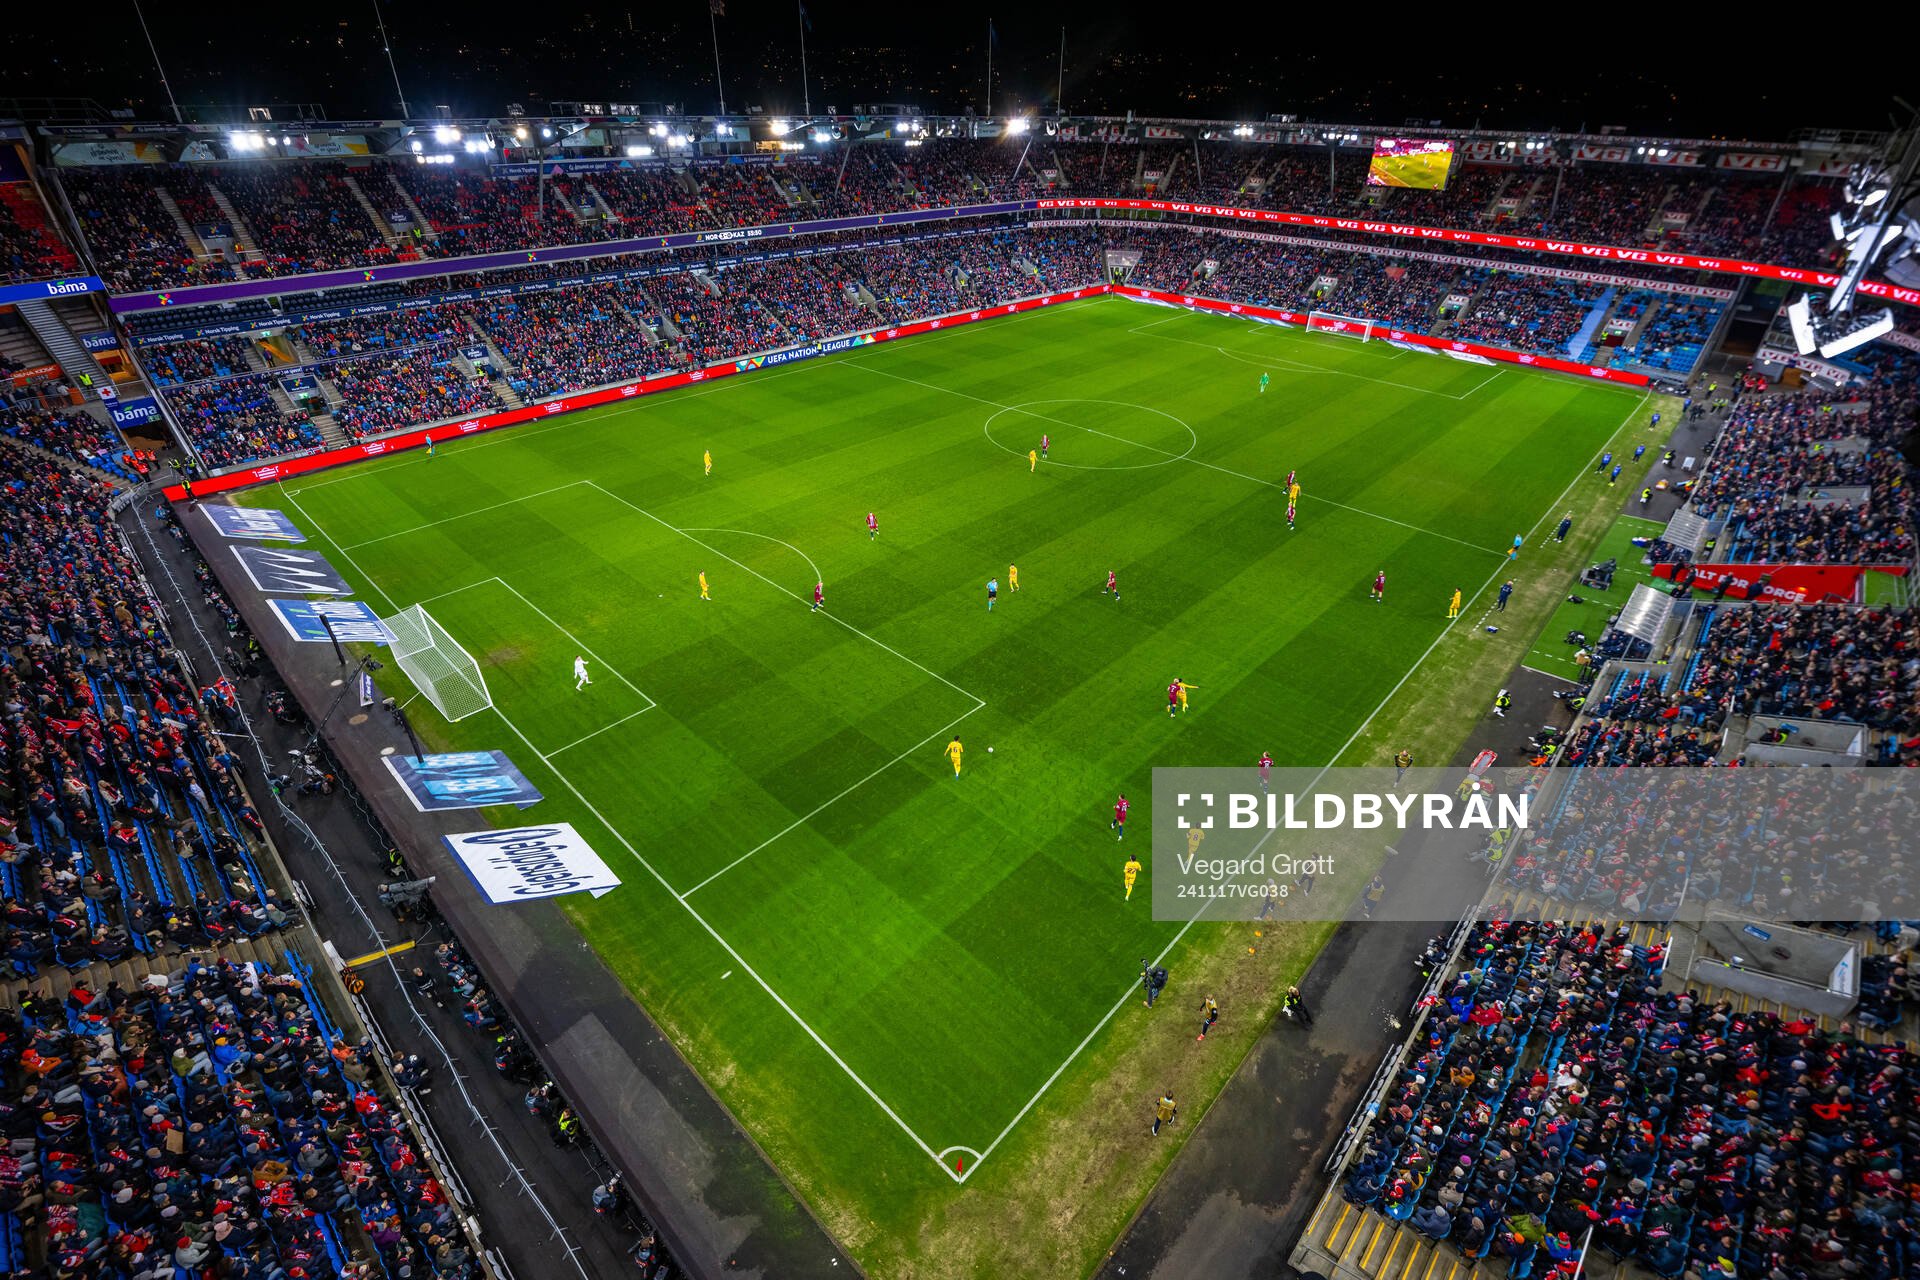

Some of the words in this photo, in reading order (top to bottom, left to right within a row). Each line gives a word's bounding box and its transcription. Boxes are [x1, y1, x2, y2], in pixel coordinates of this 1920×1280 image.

[1576, 147, 1625, 161] VG
[1722, 153, 1780, 170] VG
[1391, 226, 1414, 234] VG
[1547, 243, 1574, 252] VG
[1582, 247, 1609, 256] VG
[1617, 250, 1647, 260] VG
[1656, 255, 1683, 264] VG
[1857, 282, 1887, 295] VG
[1894, 289, 1918, 302] VG
[47, 281, 88, 294] bama
[1615, 277, 1639, 287] VG
[1643, 280, 1668, 290] VG
[1672, 283, 1698, 294] VG
[1702, 287, 1729, 297] VG
[82, 336, 117, 349] bama
[768, 353, 786, 363] UEFA
[788, 346, 818, 359] NATION
[823, 340, 850, 352] LEAGUE
[114, 405, 157, 422] bama
[1762, 586, 1806, 602] ORGE
[488, 840, 594, 894] Gjensidige
